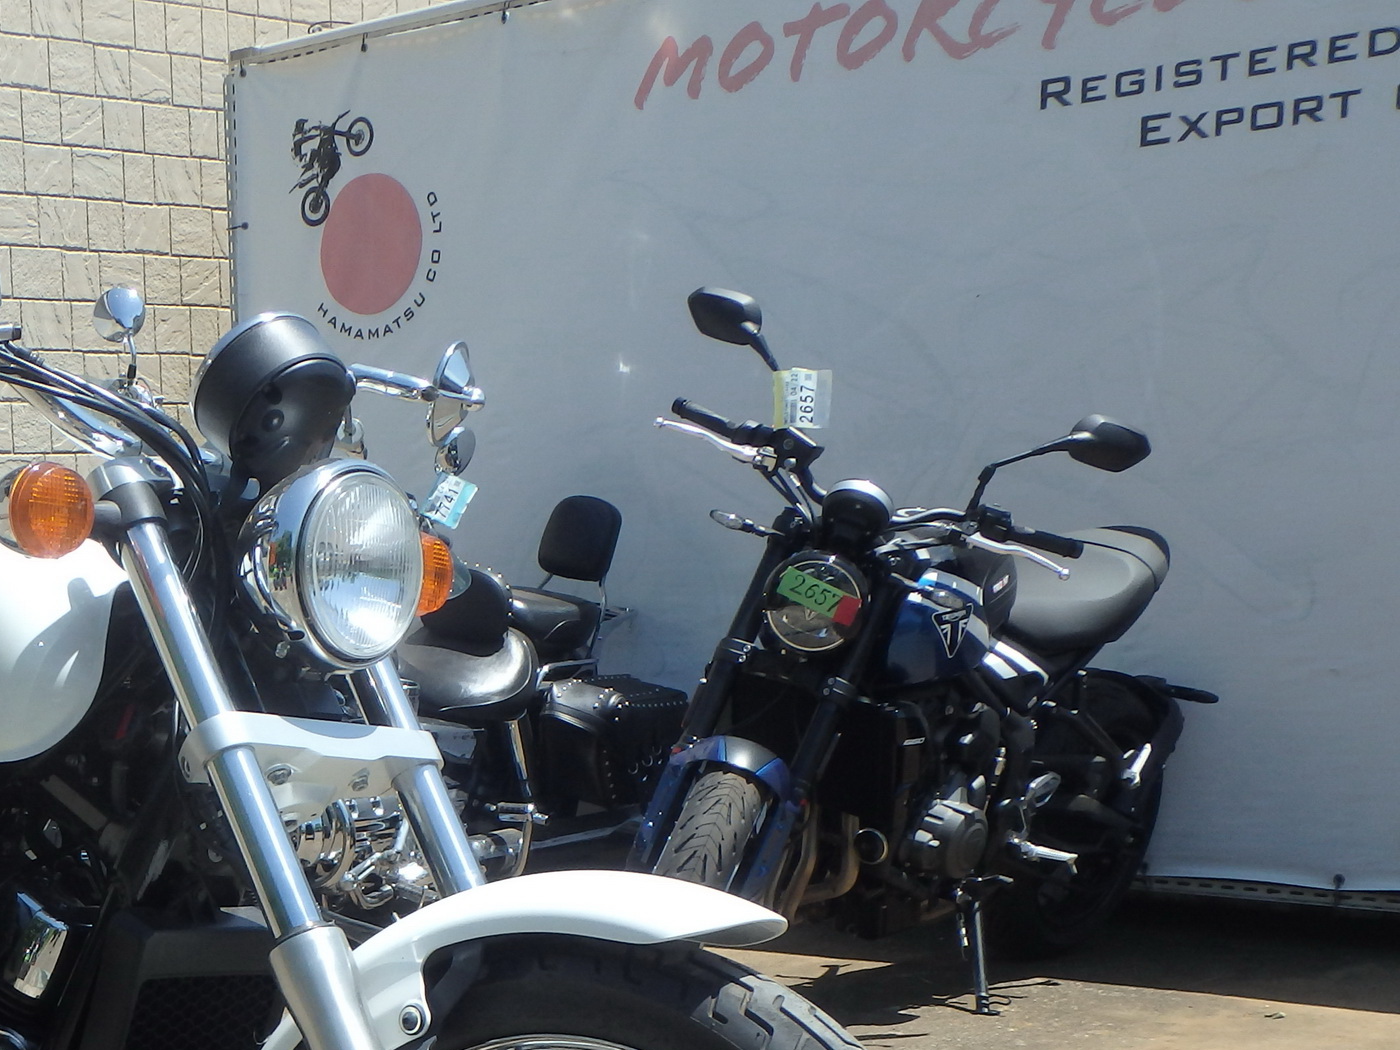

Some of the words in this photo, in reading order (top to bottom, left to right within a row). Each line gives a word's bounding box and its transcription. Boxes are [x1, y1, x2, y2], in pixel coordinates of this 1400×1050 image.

[633, 0, 1190, 110] MOTORCY
[1039, 26, 1400, 110] REGISTERED
[1139, 89, 1363, 147] EXPORT
[427, 191, 442, 233] LTD
[426, 249, 441, 282] CO
[317, 292, 426, 340] HAMAMATSU
[799, 385, 814, 423] 2657
[435, 489, 459, 518] 7741
[789, 574, 843, 613] 2657
